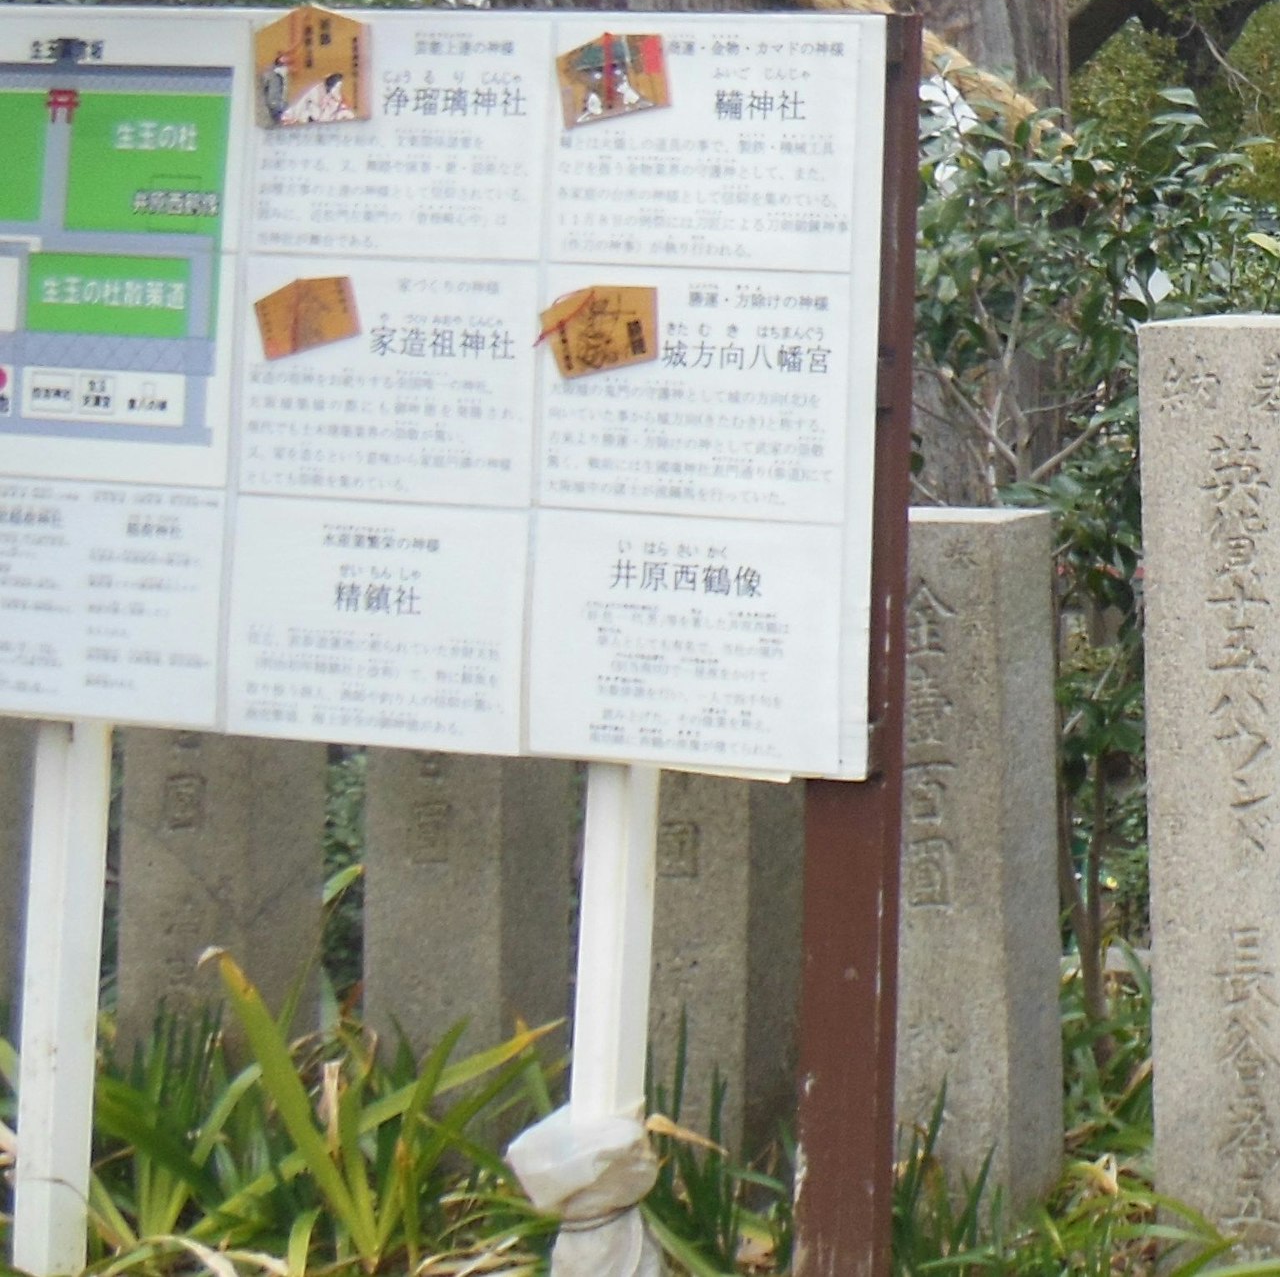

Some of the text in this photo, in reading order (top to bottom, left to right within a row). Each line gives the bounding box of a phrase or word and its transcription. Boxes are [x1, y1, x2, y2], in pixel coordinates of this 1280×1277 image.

[383, 85, 528, 118] 浄瑠璃神社
[369, 325, 517, 361] 家造祖神社
[661, 340, 834, 374] 城方向八幡宮
[609, 558, 763, 599] 井原西鶴像
